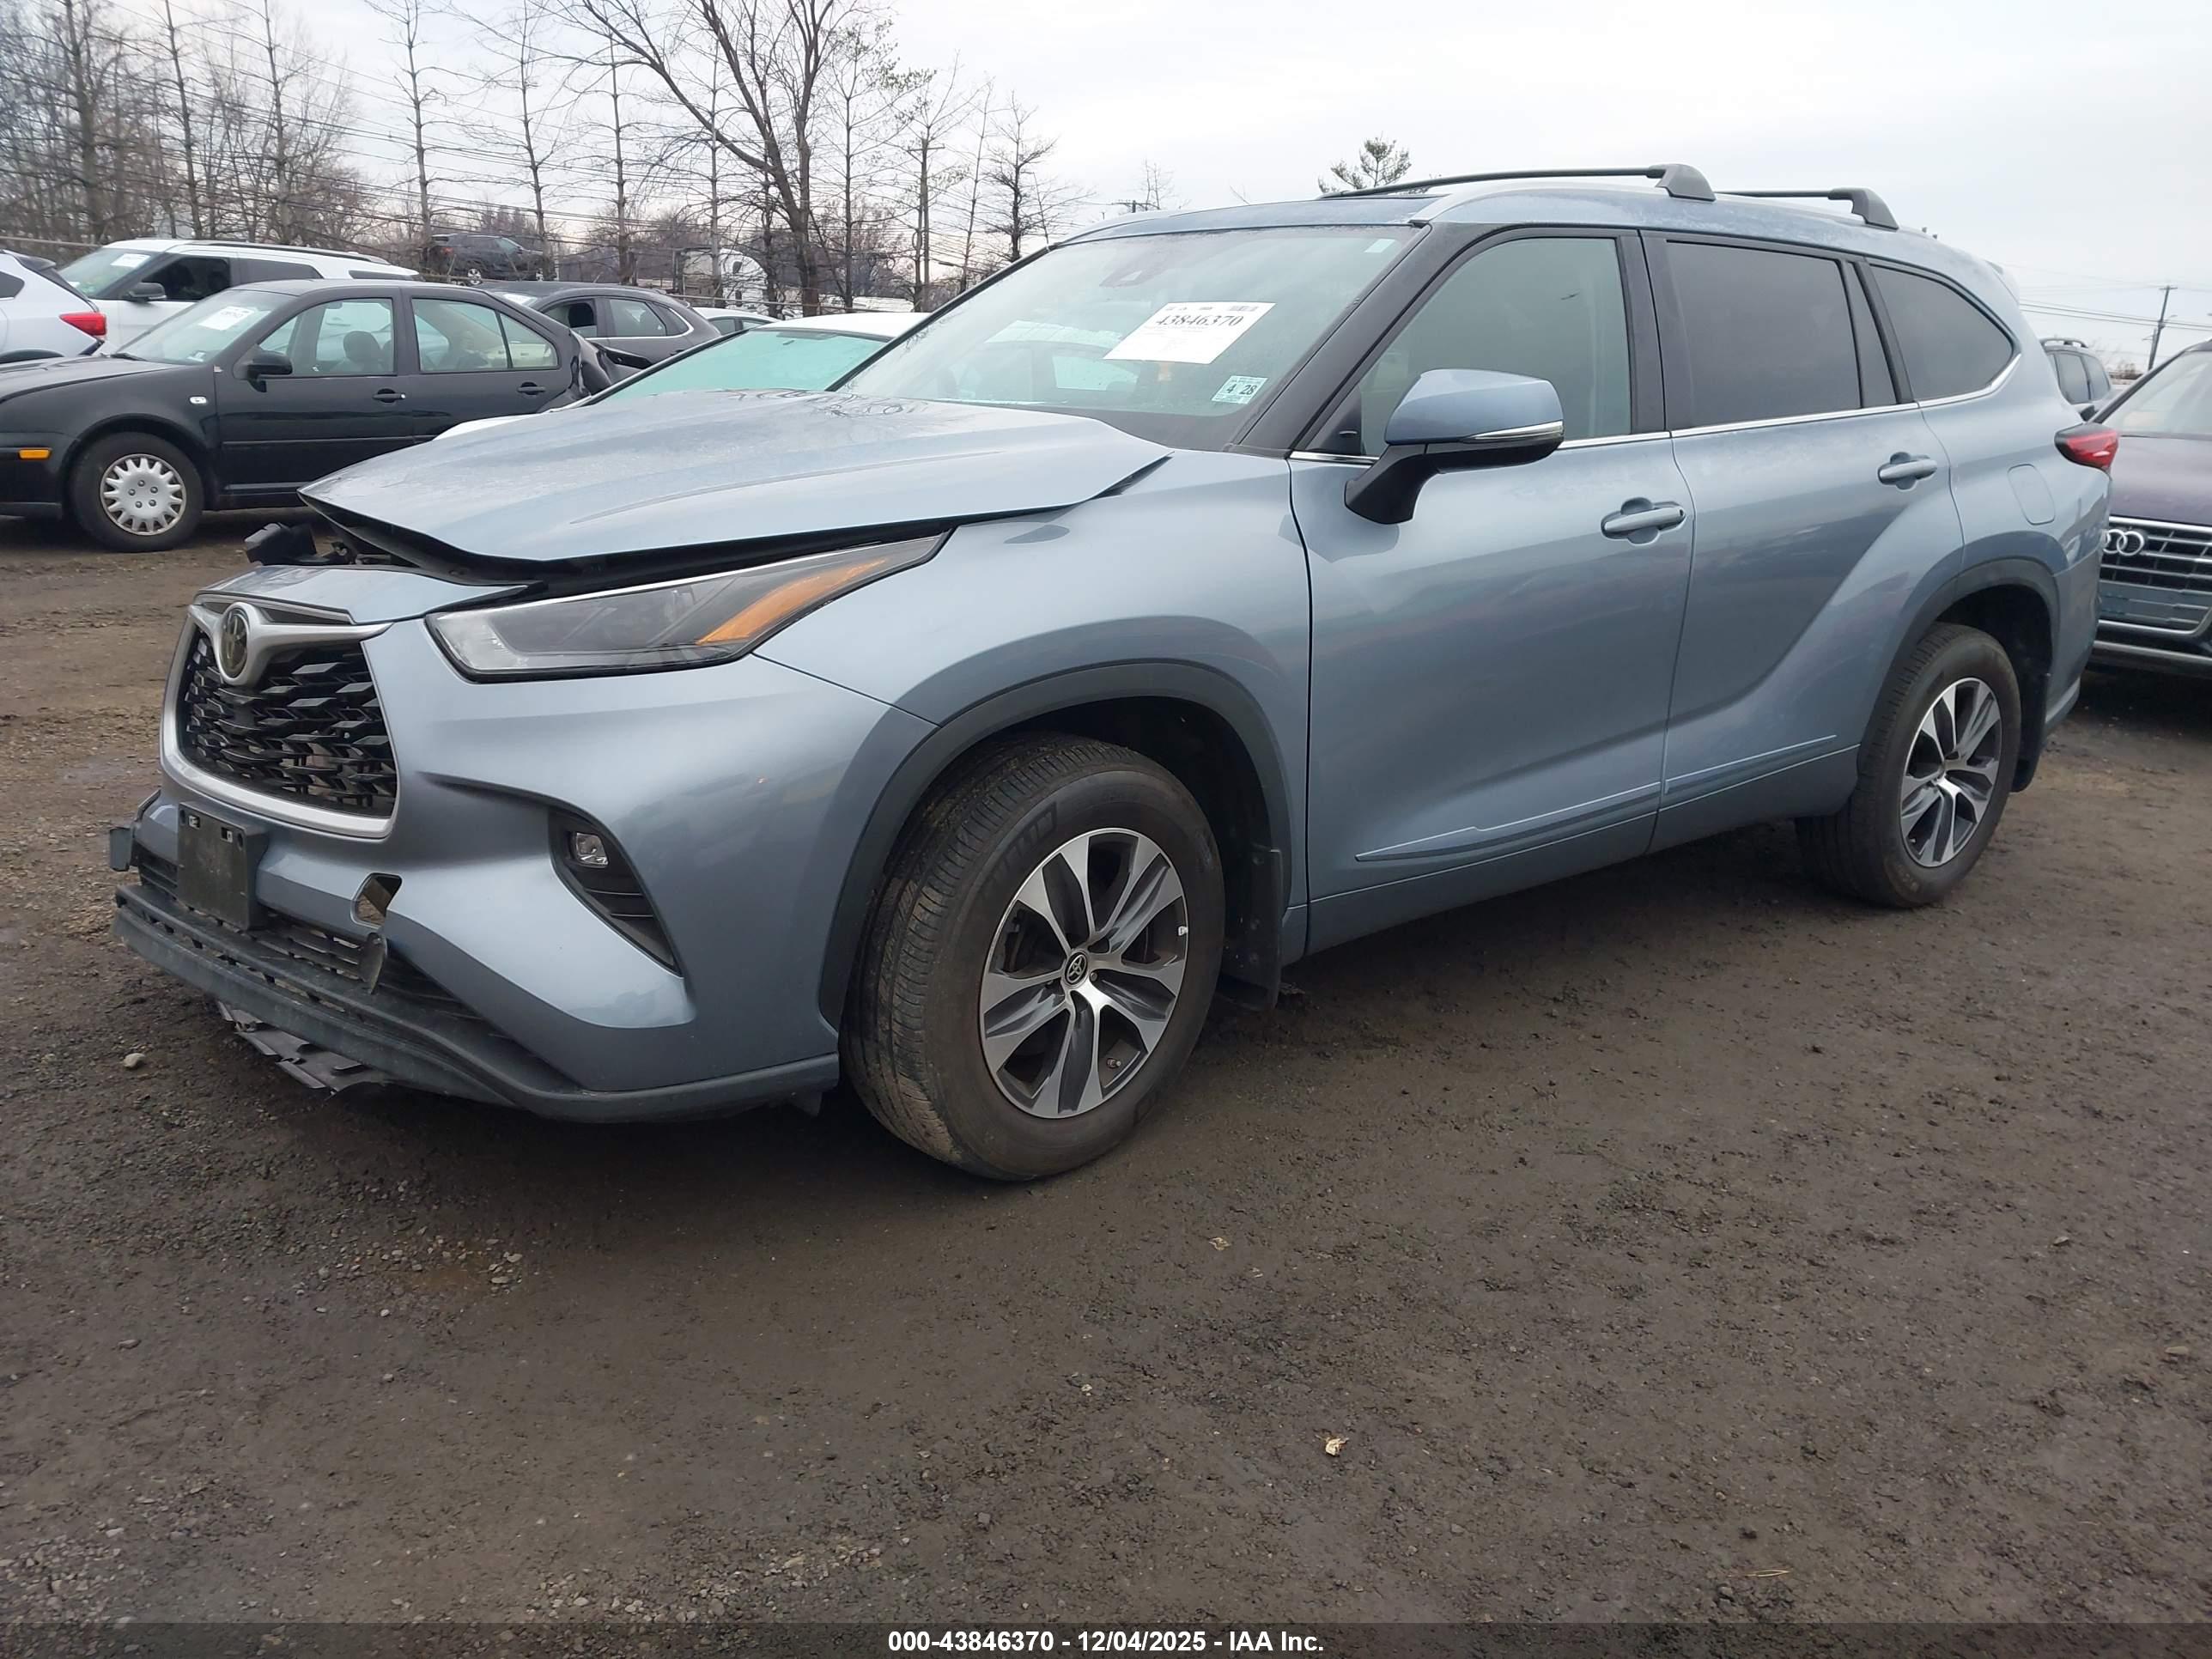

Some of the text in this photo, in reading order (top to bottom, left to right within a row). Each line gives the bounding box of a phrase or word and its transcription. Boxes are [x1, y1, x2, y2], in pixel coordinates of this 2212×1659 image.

[1155, 314, 1245, 327] 43846370
[1226, 383, 1258, 395] 4 28
